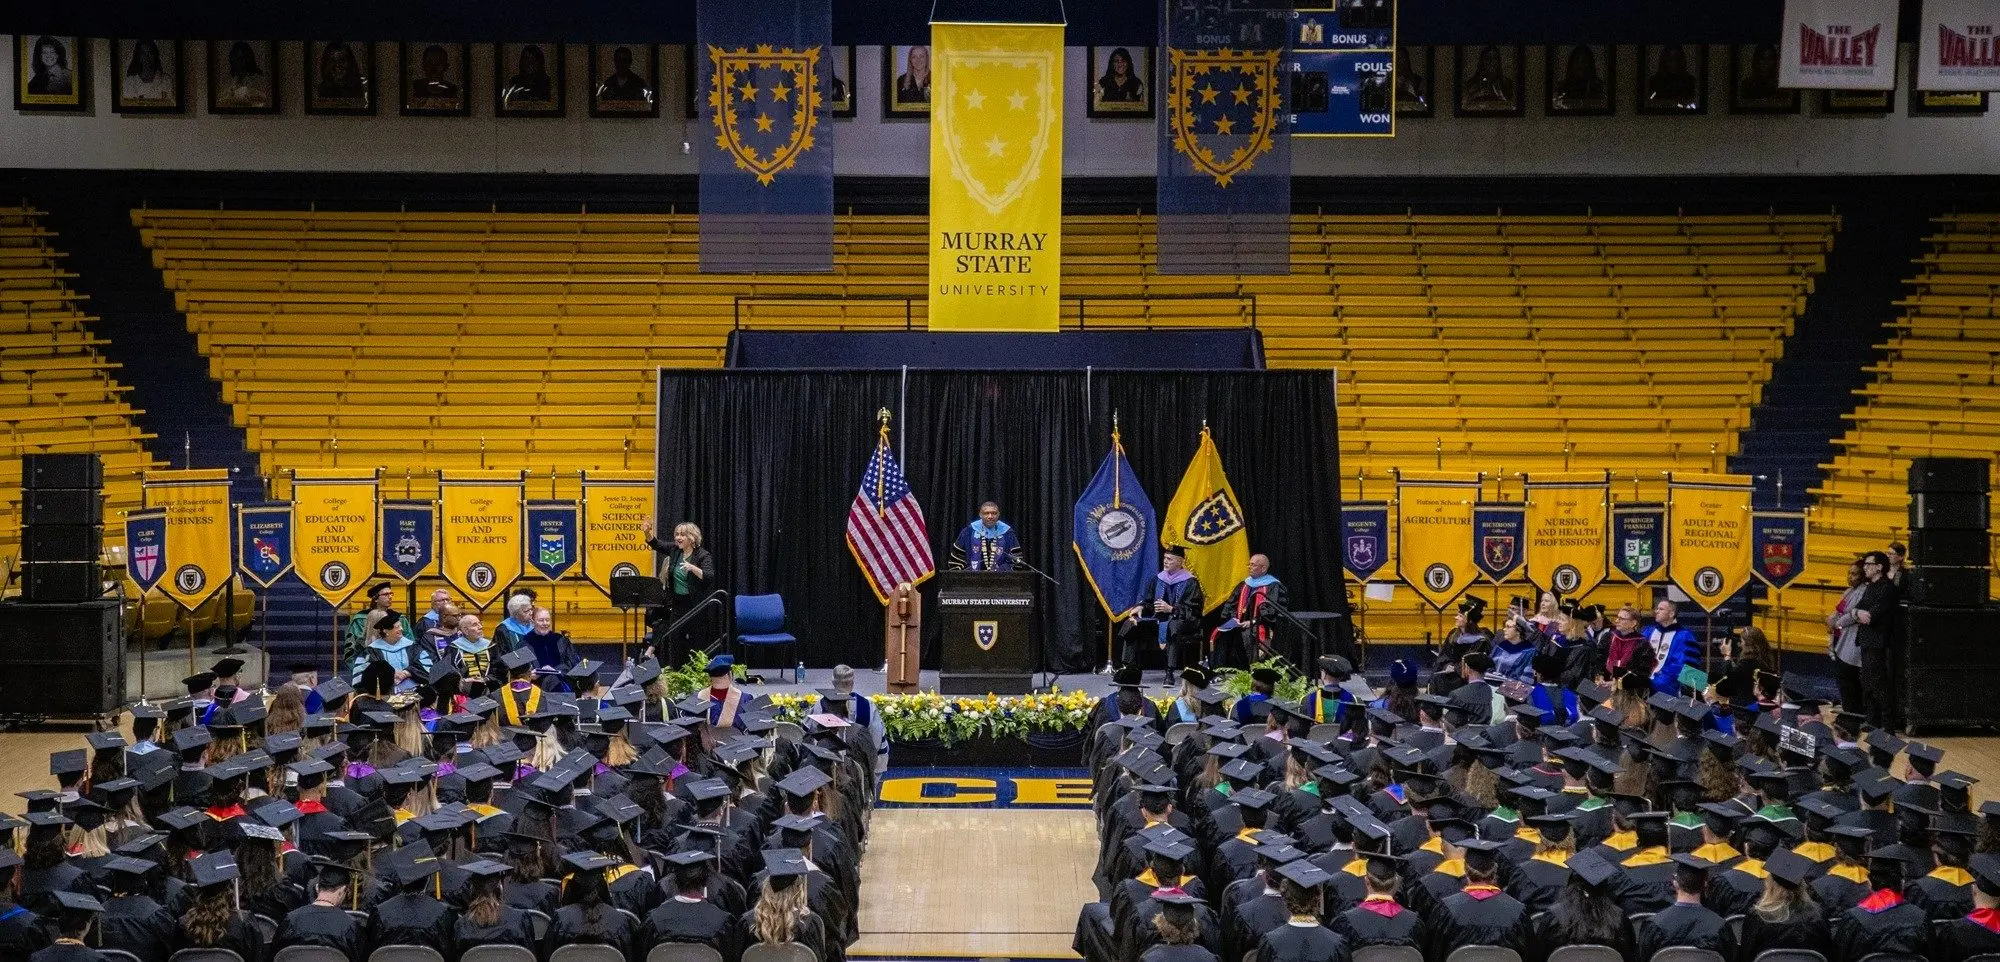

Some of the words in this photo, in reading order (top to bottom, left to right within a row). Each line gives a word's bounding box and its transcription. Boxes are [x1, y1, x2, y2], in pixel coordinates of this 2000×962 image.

[1196, 35, 1231, 44] BONUS
[1332, 34, 1367, 44] BONUS
[1800, 23, 1880, 66] VALLEY
[1354, 62, 1393, 72] FOULS
[1360, 114, 1391, 123] WON
[941, 232, 1047, 251] MURRAY
[956, 255, 1032, 273] STATE
[940, 284, 1048, 296] UNIVERSITY
[609, 503, 633, 511] College
[305, 515, 365, 523] EDUCATION
[451, 516, 514, 524] HUMANITIES
[1545, 518, 1589, 527] NURSING
[590, 523, 653, 531] ENGINEER
[1682, 519, 1716, 528] ADULT
[1717, 521, 1739, 529] AND
[324, 525, 346, 533] AND
[1536, 528, 1557, 537] AND
[1559, 528, 1598, 536] HEALTH
[614, 533, 636, 541] AND
[1685, 529, 1735, 539] REGIONAL
[316, 535, 354, 543] HUMAN
[456, 536, 480, 544] FINE
[482, 536, 508, 544] ARTS
[1534, 538, 1601, 547] PROFESSIONS
[1680, 539, 1740, 550] EDUCATION
[311, 545, 360, 554] SERVICES
[941, 598, 969, 606] MURRAY
[969, 598, 990, 606] STATE
[990, 598, 1031, 606] UNIVERSITY
